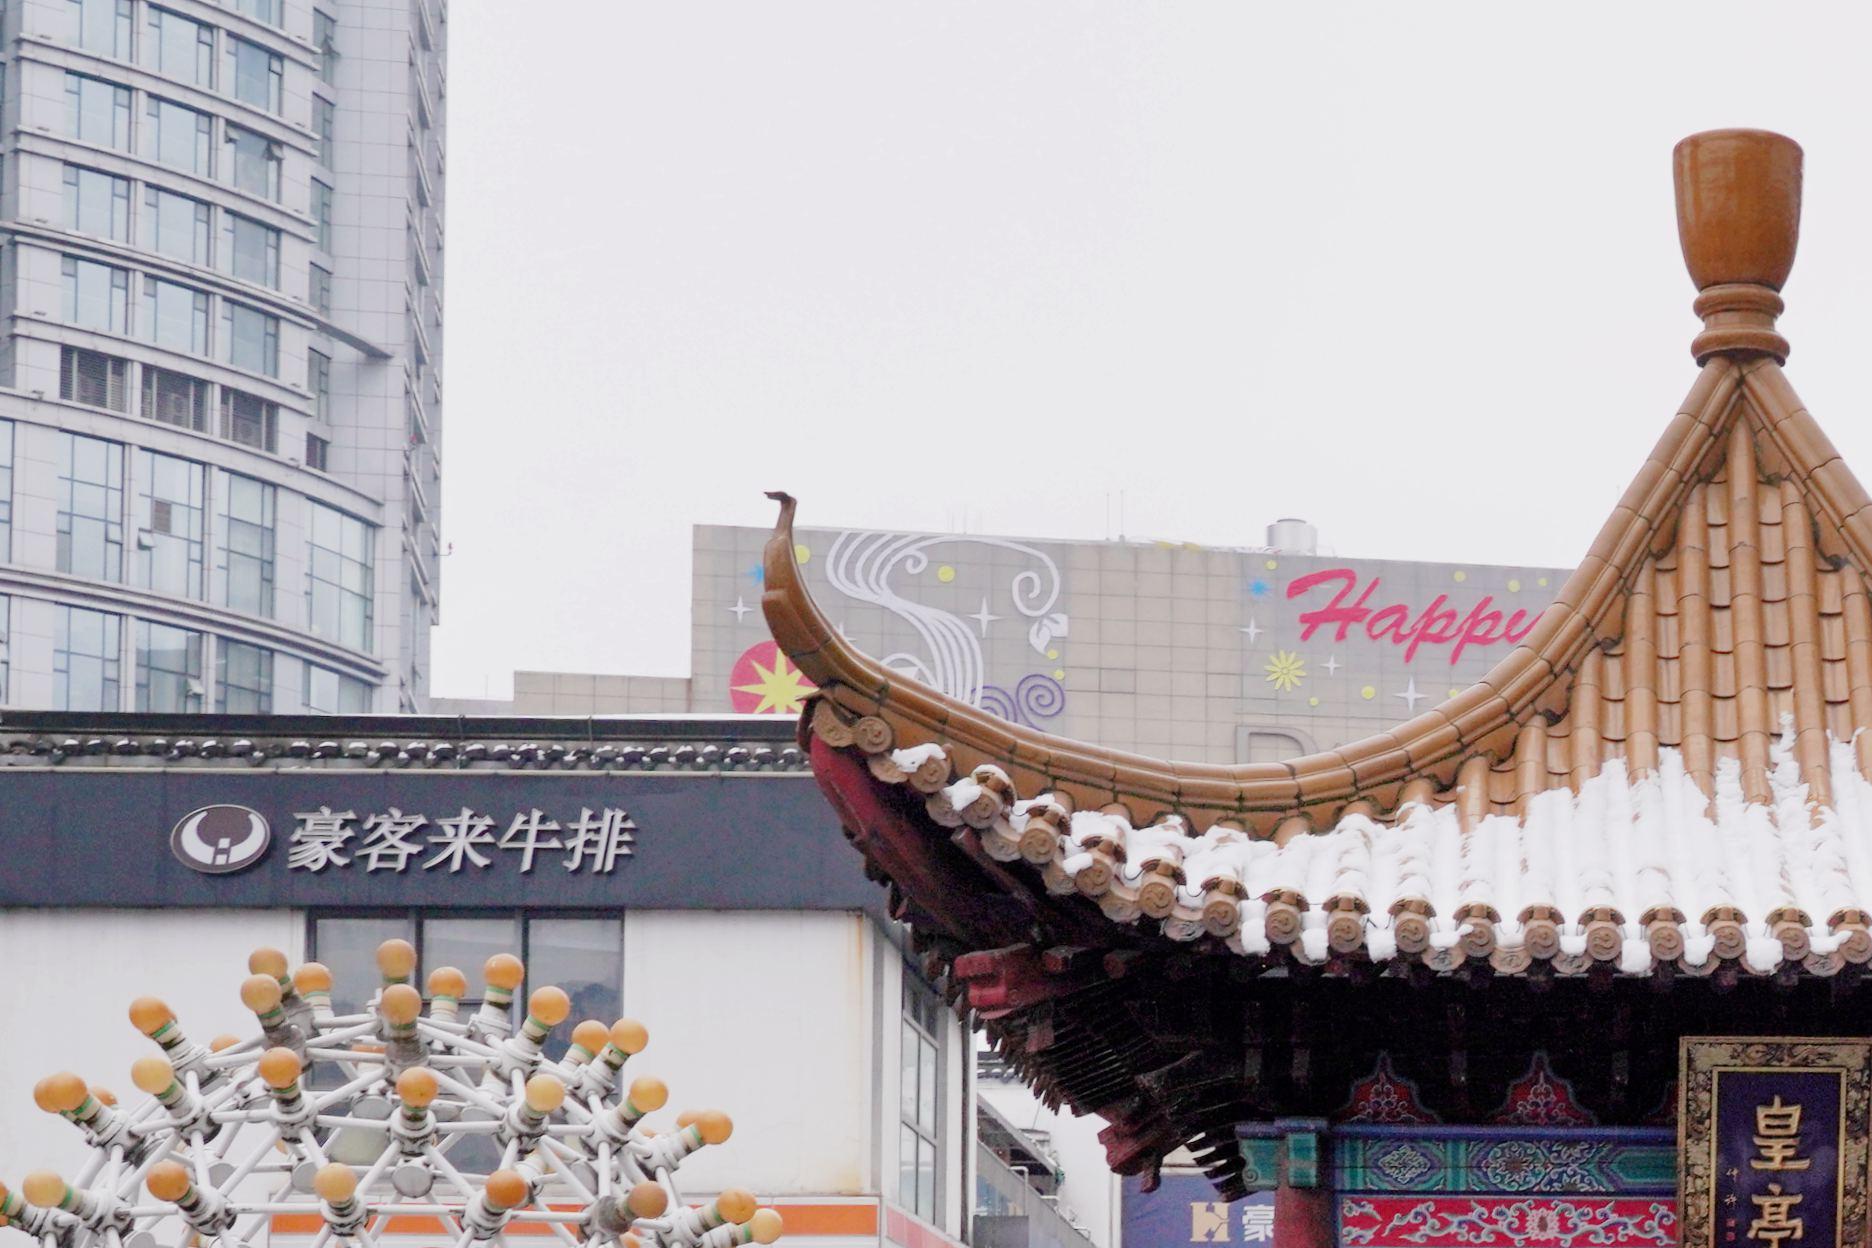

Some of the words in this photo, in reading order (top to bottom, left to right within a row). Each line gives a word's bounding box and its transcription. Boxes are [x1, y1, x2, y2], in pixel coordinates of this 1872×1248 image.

[288, 805, 637, 875] 豪客来牛排
